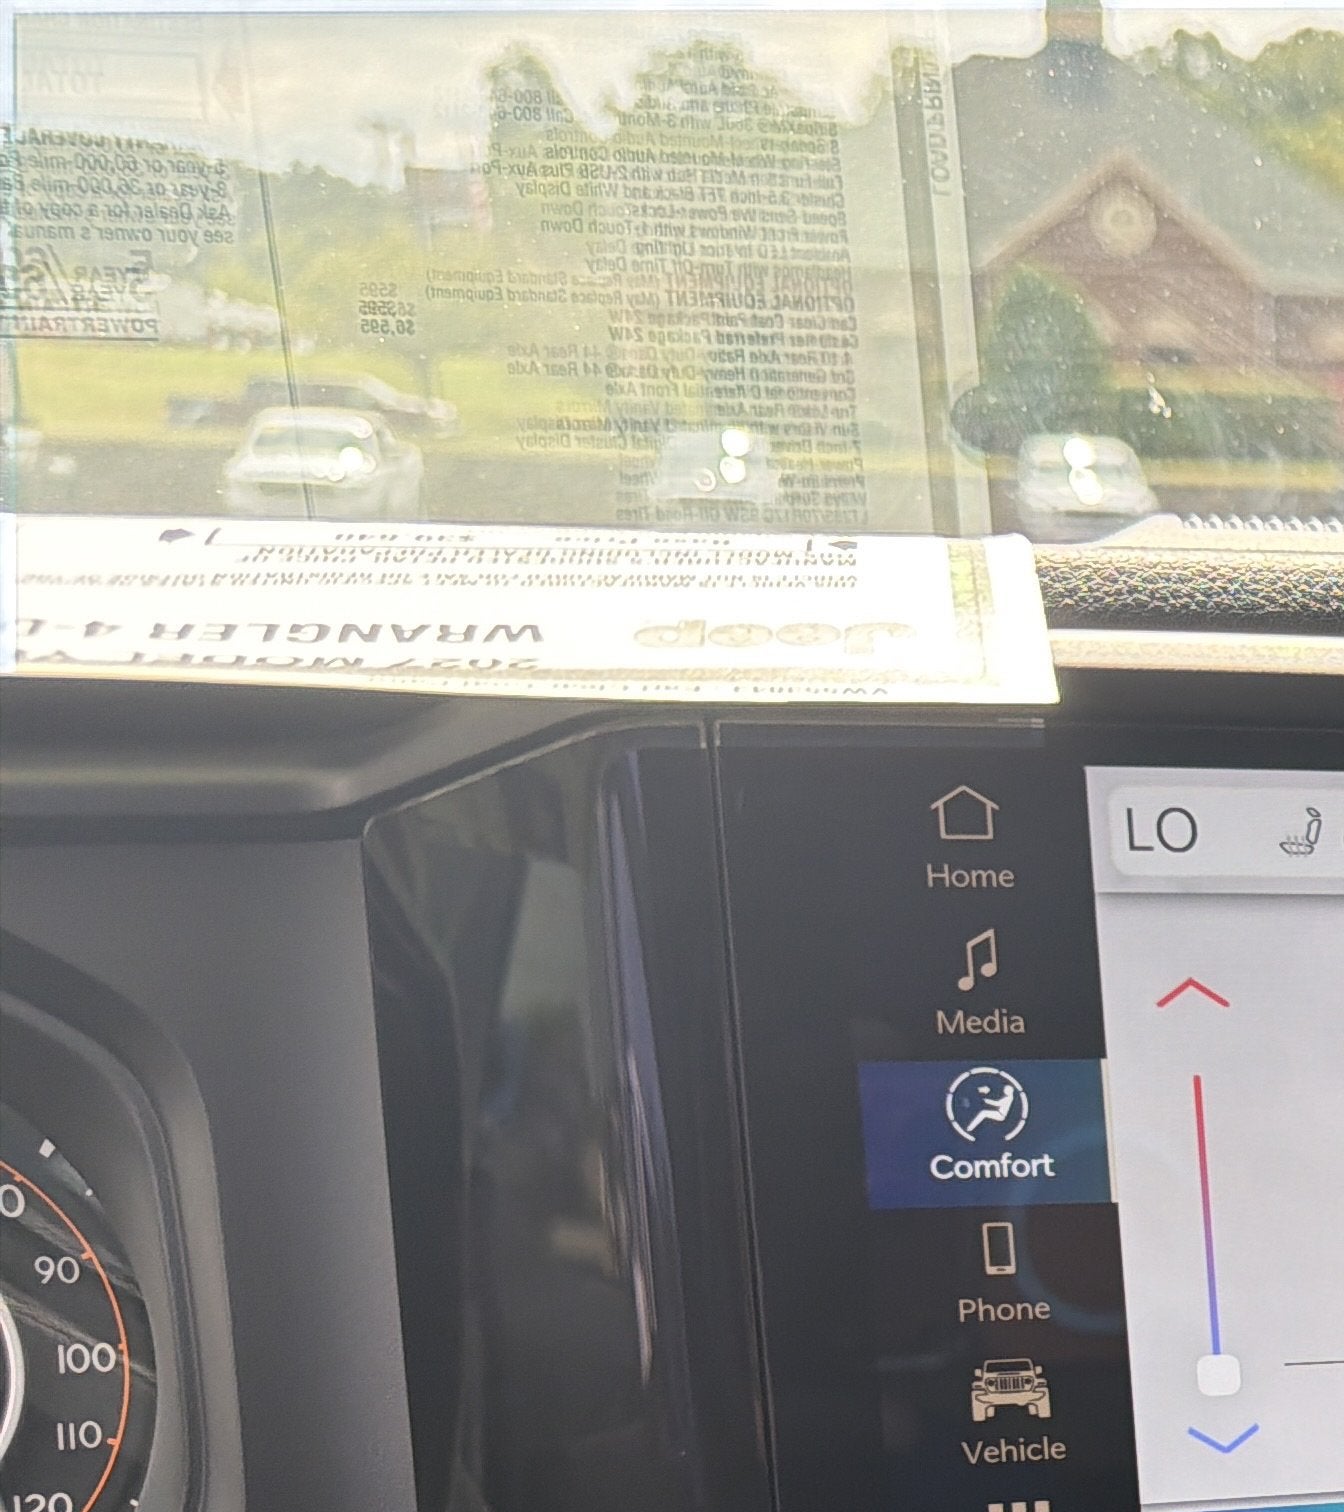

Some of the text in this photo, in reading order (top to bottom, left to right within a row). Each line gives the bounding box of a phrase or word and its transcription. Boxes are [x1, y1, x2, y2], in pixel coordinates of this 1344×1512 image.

[149, 623, 544, 643] WRANGLER
[1126, 806, 1198, 853] LO
[926, 863, 1016, 890] Home
[936, 1009, 1026, 1036] Media
[929, 1152, 1056, 1181] Comfort
[0, 1183, 26, 1218] 0
[33, 1255, 81, 1284] 90
[957, 1297, 1052, 1324] Phone
[56, 1342, 117, 1375] 100
[55, 1420, 103, 1451] 110
[960, 1437, 1067, 1466] Vehicle
